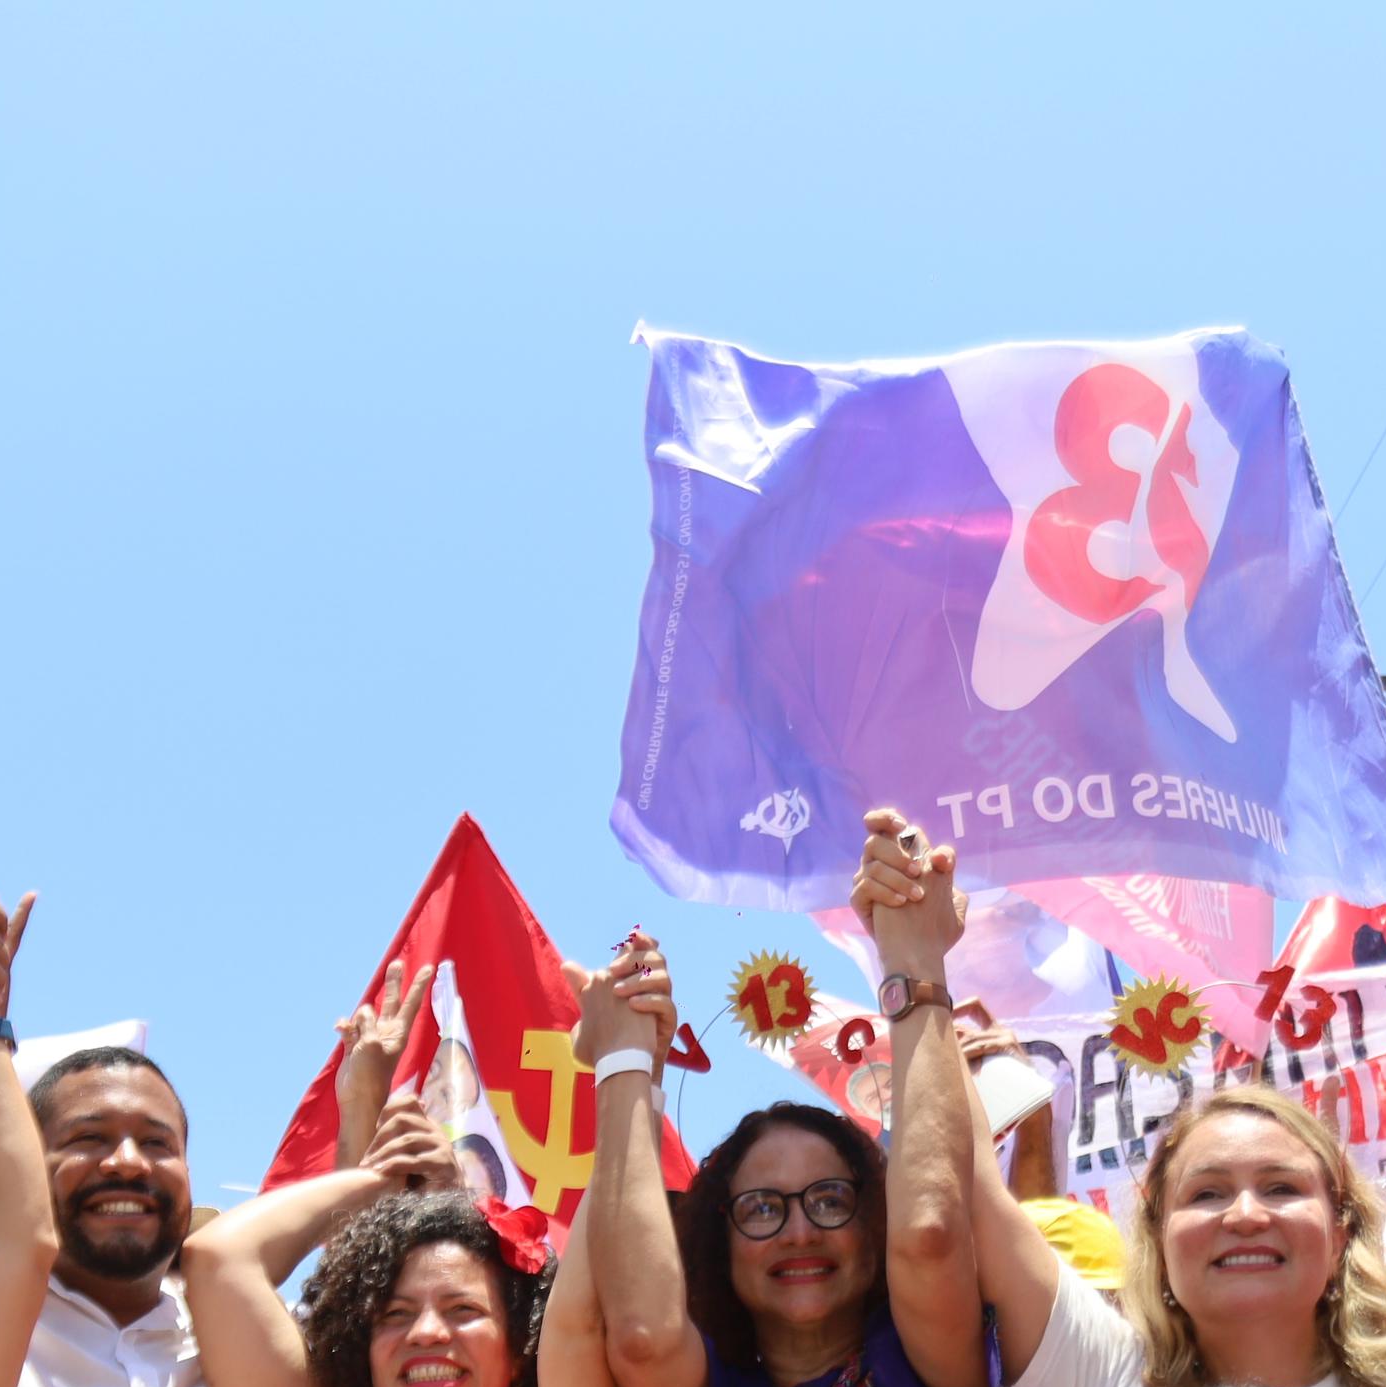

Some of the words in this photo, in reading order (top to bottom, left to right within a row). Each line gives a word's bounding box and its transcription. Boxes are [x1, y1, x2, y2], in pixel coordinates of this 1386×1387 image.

[739, 964, 813, 1032] 13
[1110, 992, 1201, 1063] VC
[1255, 965, 1337, 1050] 13
